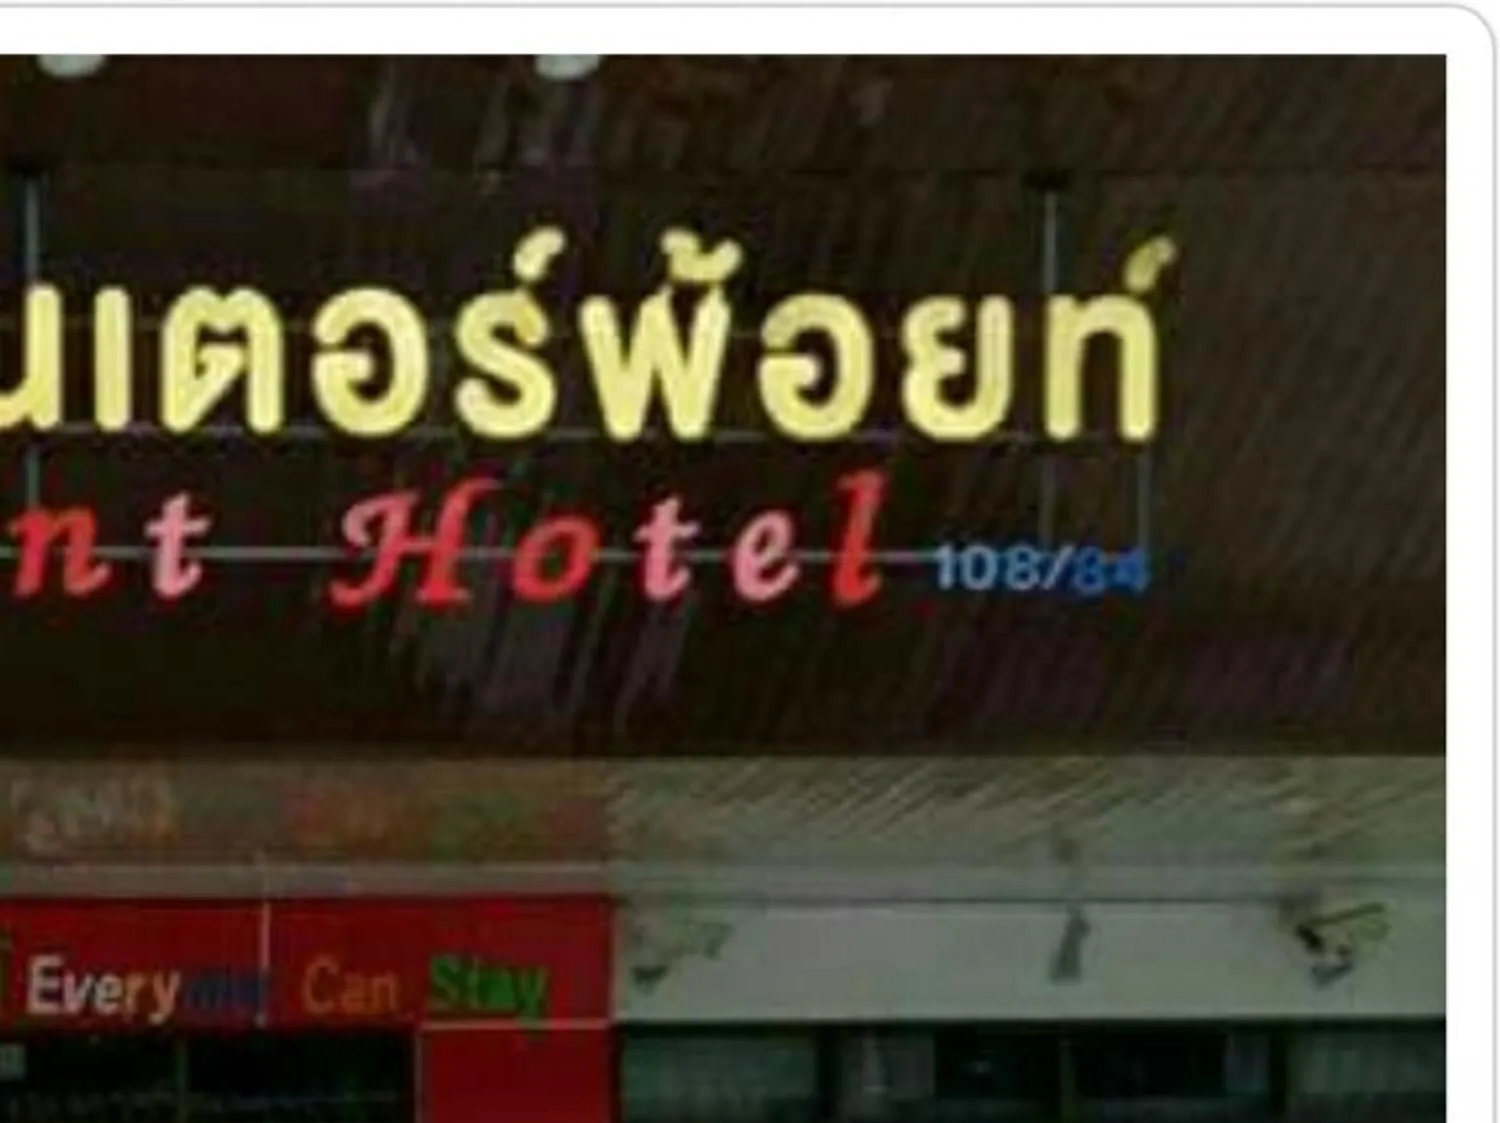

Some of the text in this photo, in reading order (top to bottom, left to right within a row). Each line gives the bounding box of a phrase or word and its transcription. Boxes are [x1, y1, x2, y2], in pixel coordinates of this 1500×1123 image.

[330, 470, 889, 607] Hotel
[303, 957, 399, 1015] Can
[426, 953, 550, 1024] Stay
